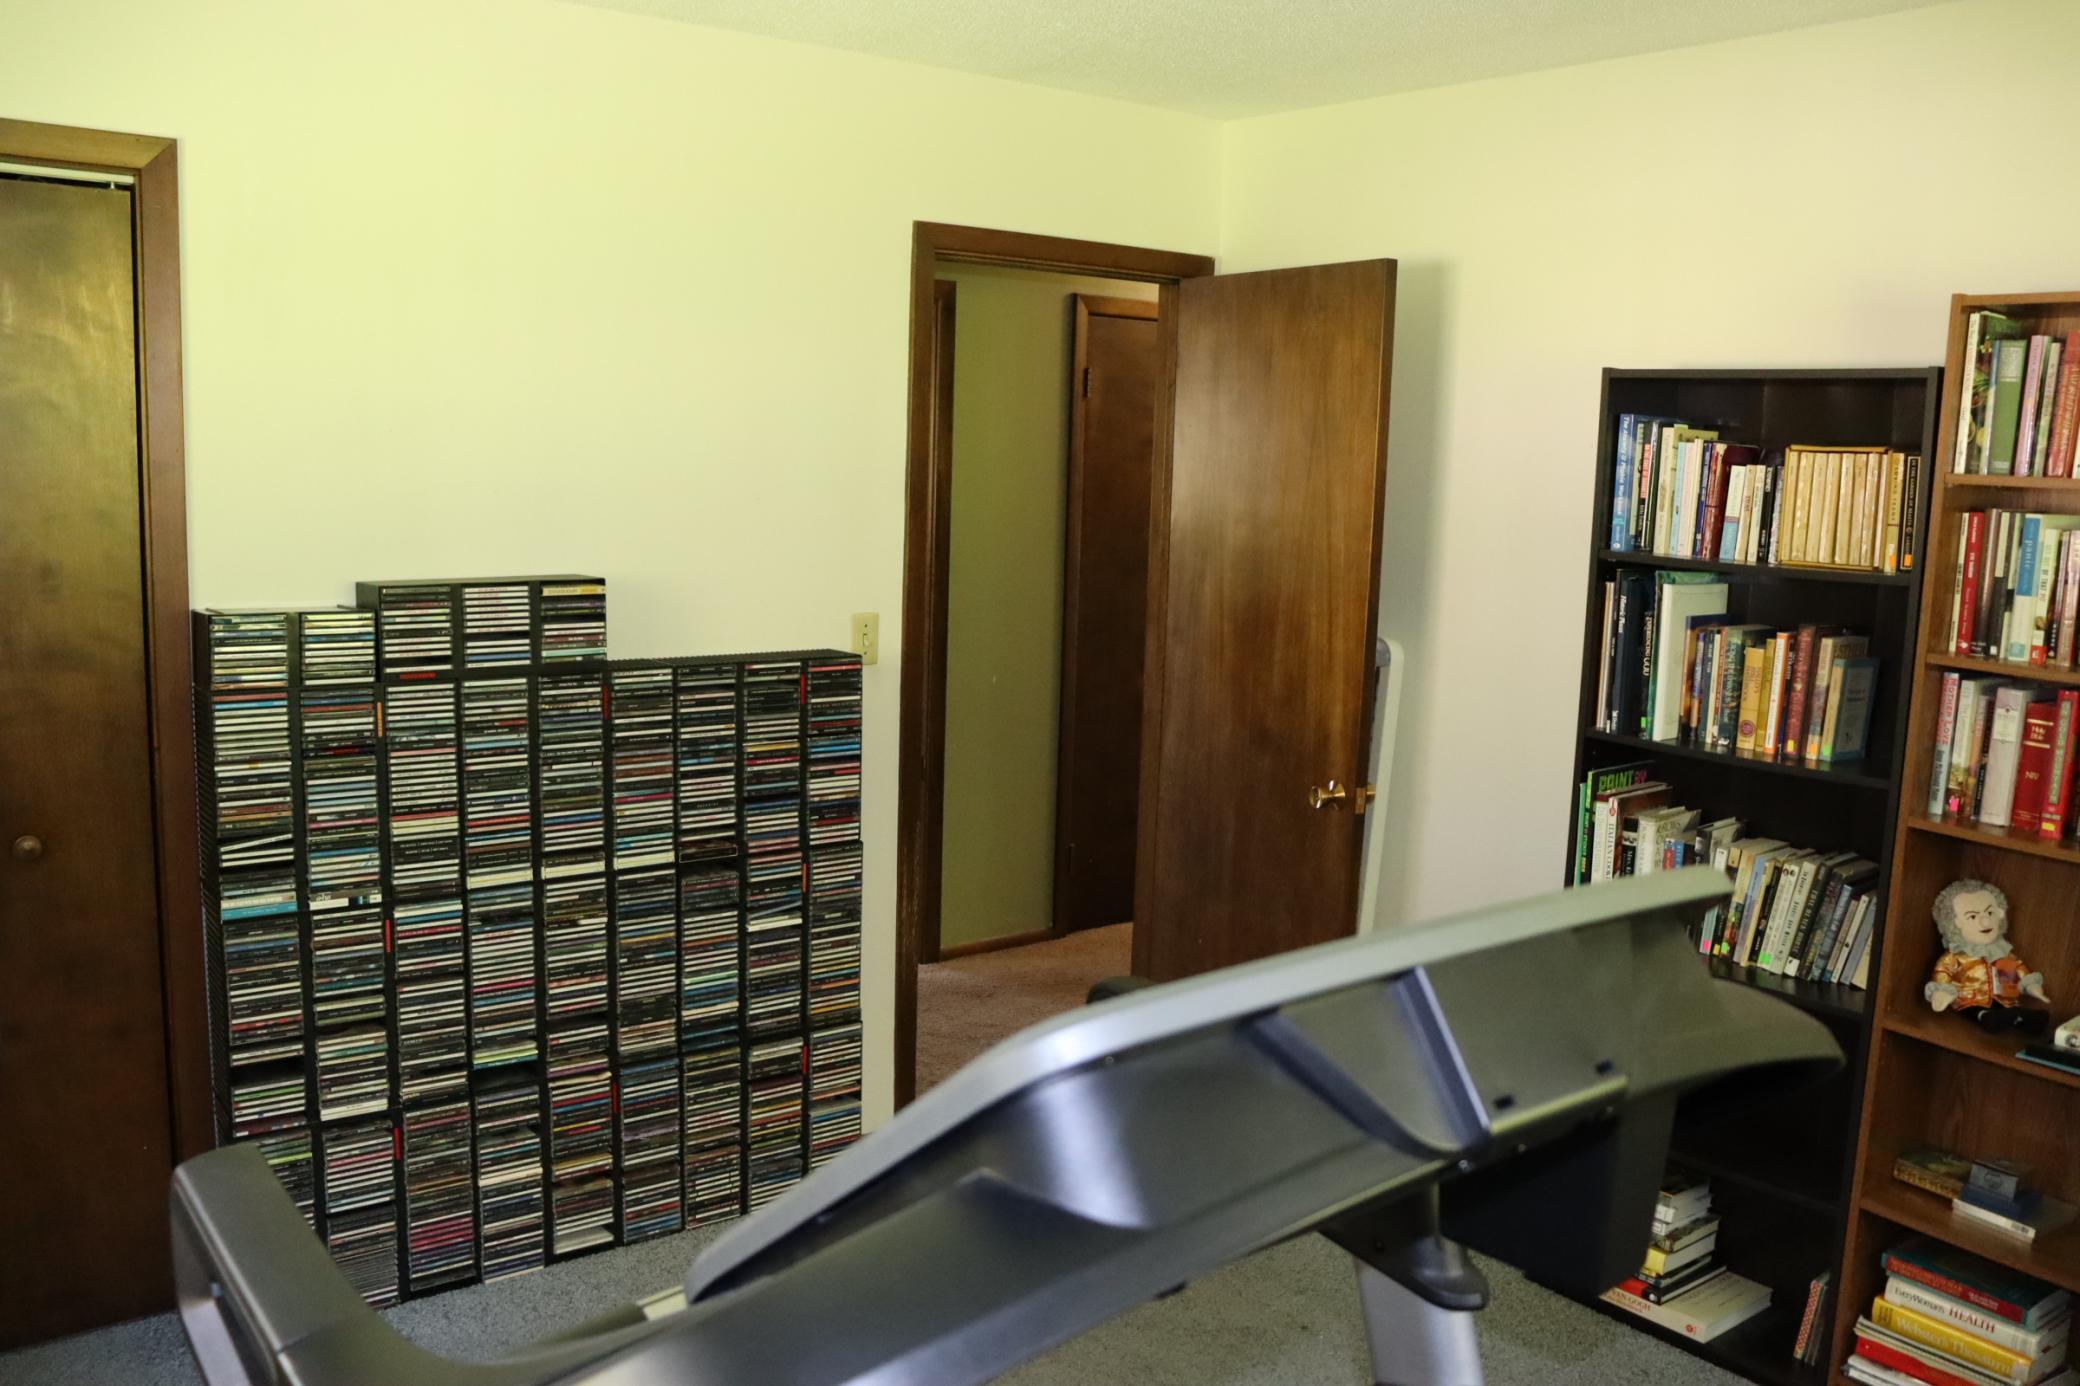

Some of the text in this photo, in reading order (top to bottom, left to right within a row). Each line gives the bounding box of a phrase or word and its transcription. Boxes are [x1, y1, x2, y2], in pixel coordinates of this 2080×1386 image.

[2024, 538, 2033, 569] panic
[1942, 719, 1951, 745] LOVE
[1949, 1306, 1996, 1333] HEALTH
